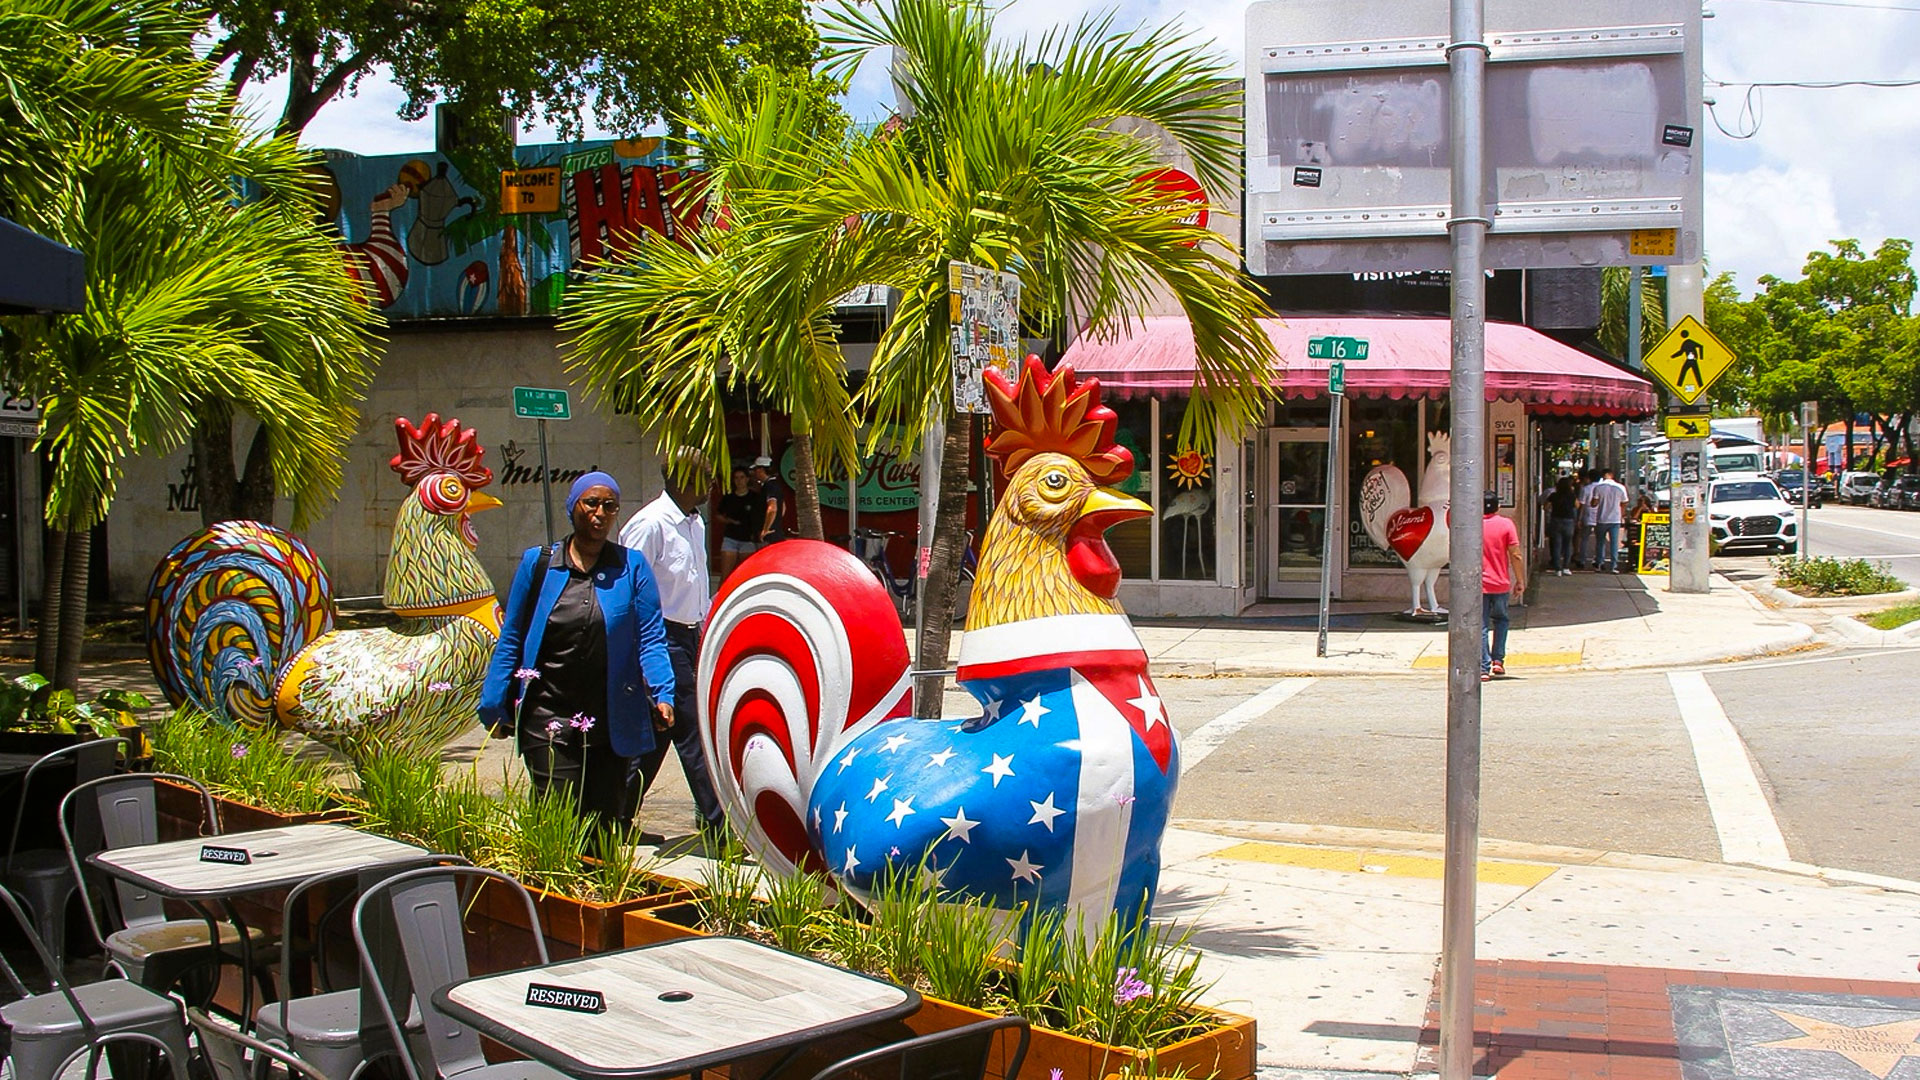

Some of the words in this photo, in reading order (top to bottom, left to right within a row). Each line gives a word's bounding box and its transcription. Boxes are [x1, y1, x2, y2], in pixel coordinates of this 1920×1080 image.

[562, 151, 609, 177] LITTLE
[505, 172, 555, 187] WELCOME
[520, 191, 536, 204] TO
[1309, 343, 1323, 355] SW
[1331, 340, 1347, 358] 16
[1356, 344, 1368, 356] AV
[1494, 420, 1516, 429] SVG
[828, 496, 873, 506] VISIRS
[875, 496, 916, 506] CENTER
[202, 848, 246, 862] RESERVED
[529, 988, 599, 1009] RESERVED
